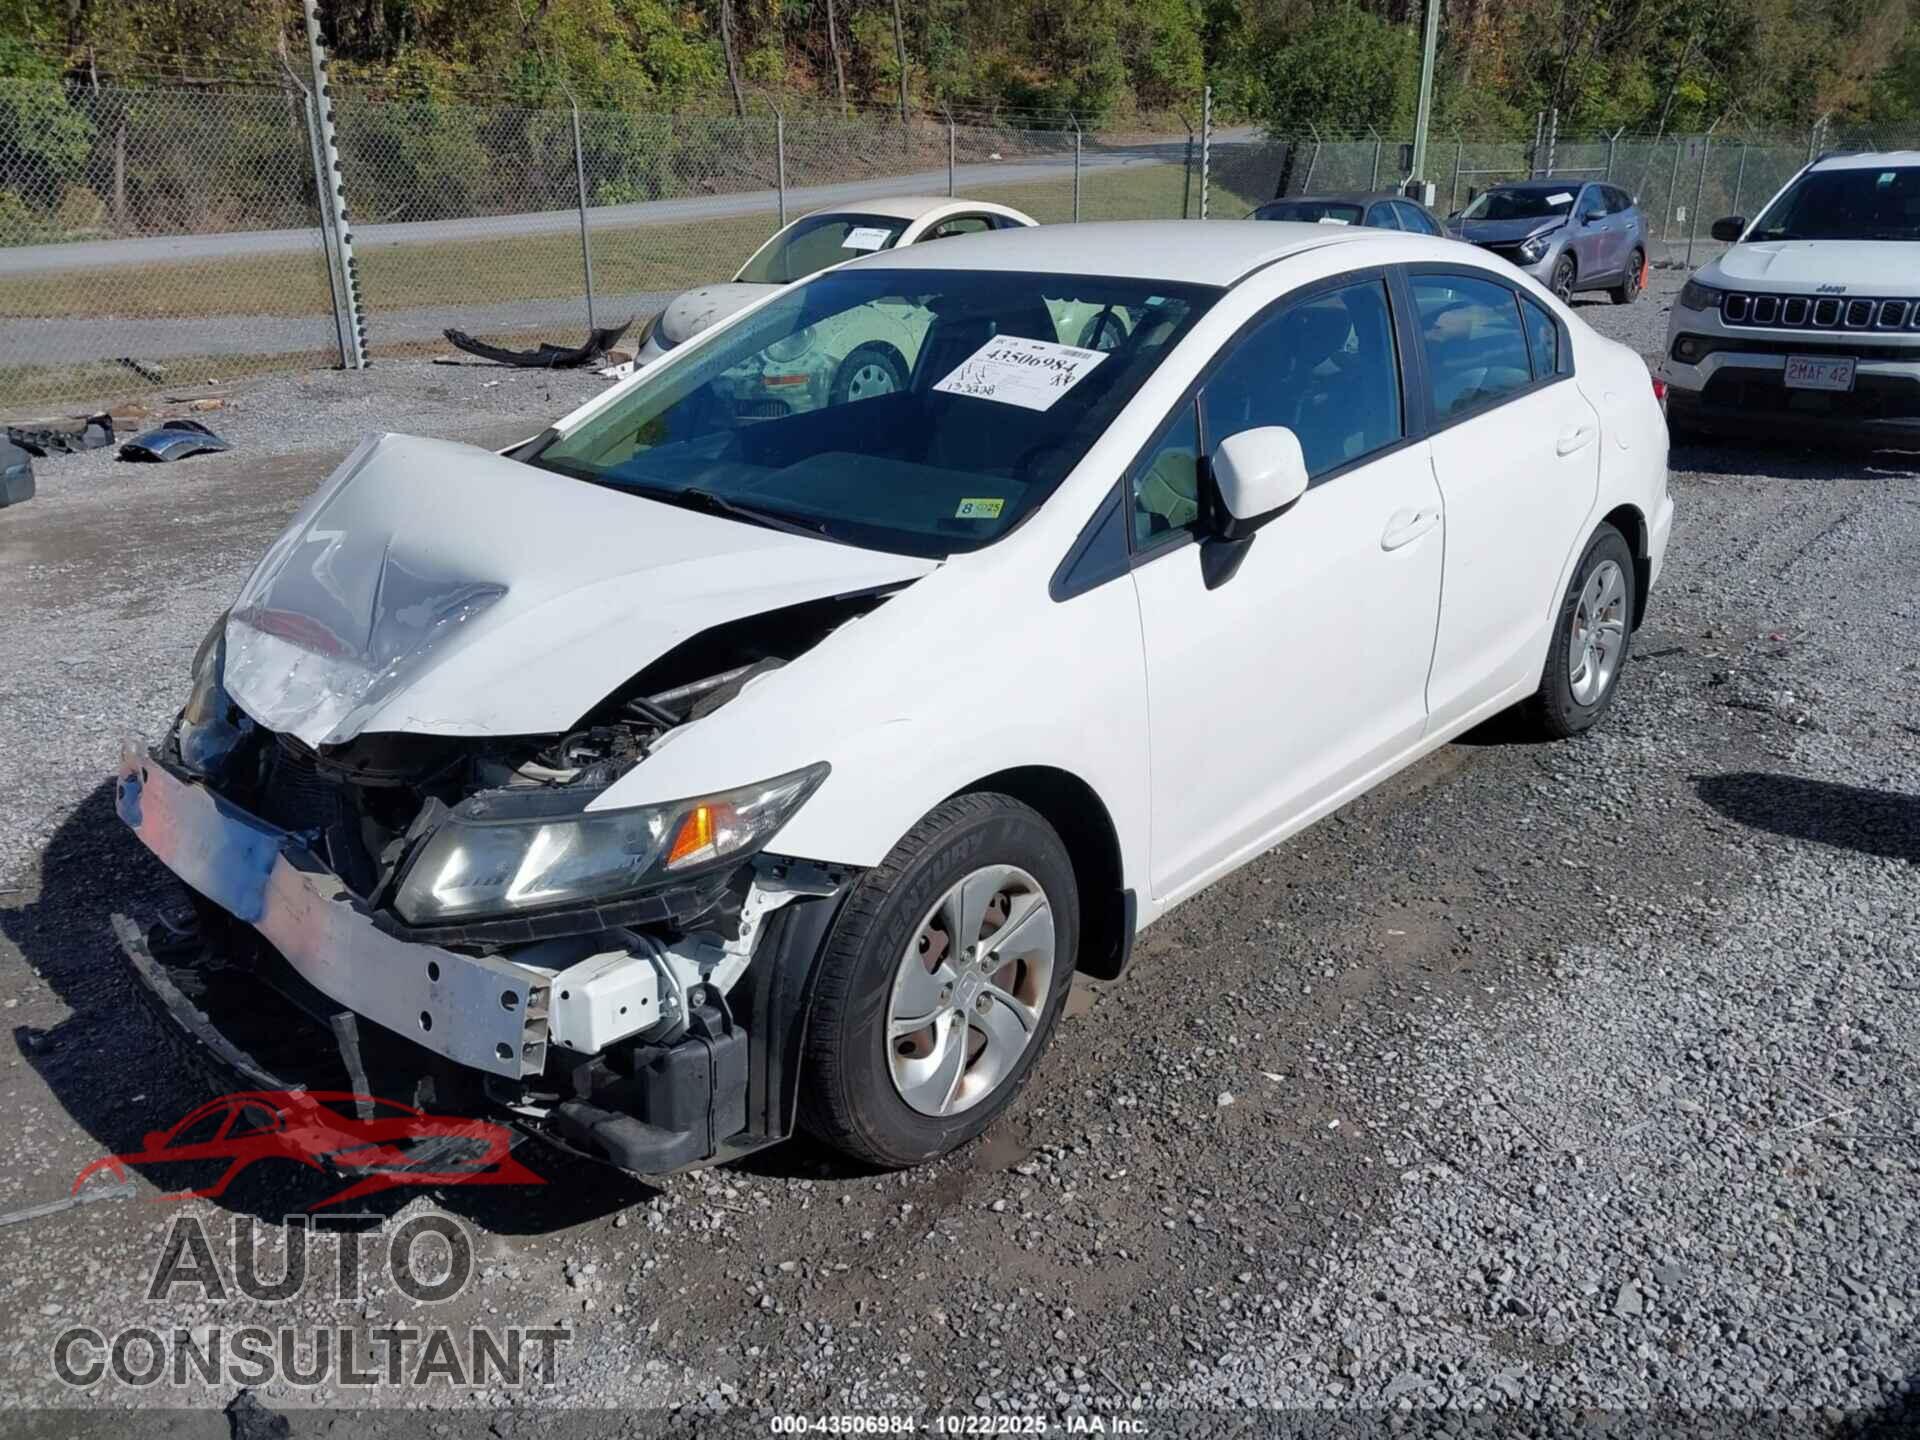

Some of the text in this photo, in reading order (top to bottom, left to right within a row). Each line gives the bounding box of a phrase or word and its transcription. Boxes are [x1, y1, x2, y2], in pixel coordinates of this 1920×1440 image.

[1816, 284, 1847, 294] Jeep
[987, 349, 1079, 372] 43506984
[1830, 367, 1849, 384] 42
[961, 502, 974, 514] 8
